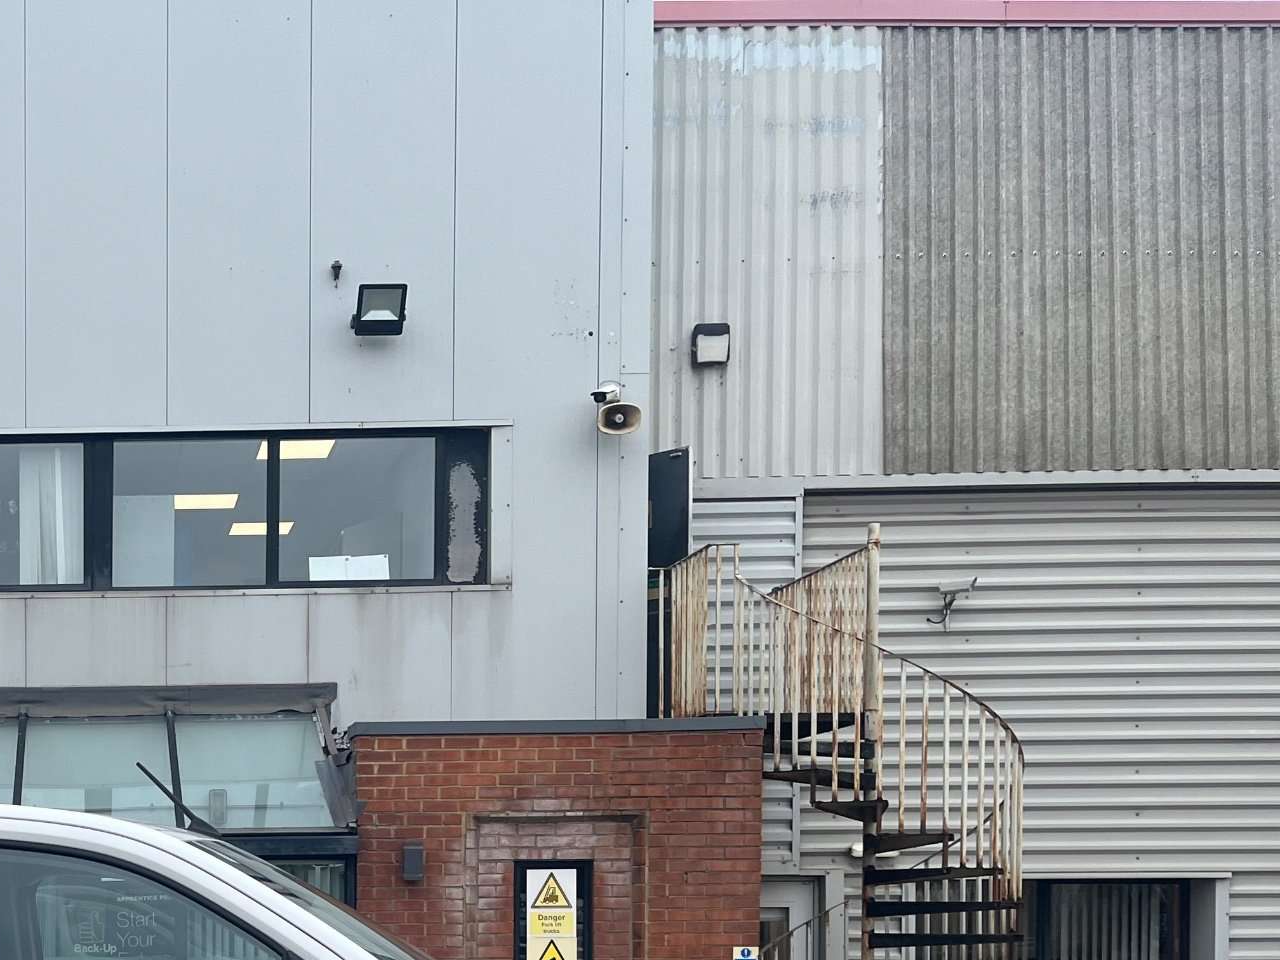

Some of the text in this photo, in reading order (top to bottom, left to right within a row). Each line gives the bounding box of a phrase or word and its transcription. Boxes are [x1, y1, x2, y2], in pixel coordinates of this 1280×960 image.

[116, 911, 158, 928] Start
[537, 914, 566, 922] Danger
[115, 932, 156, 948] Your
